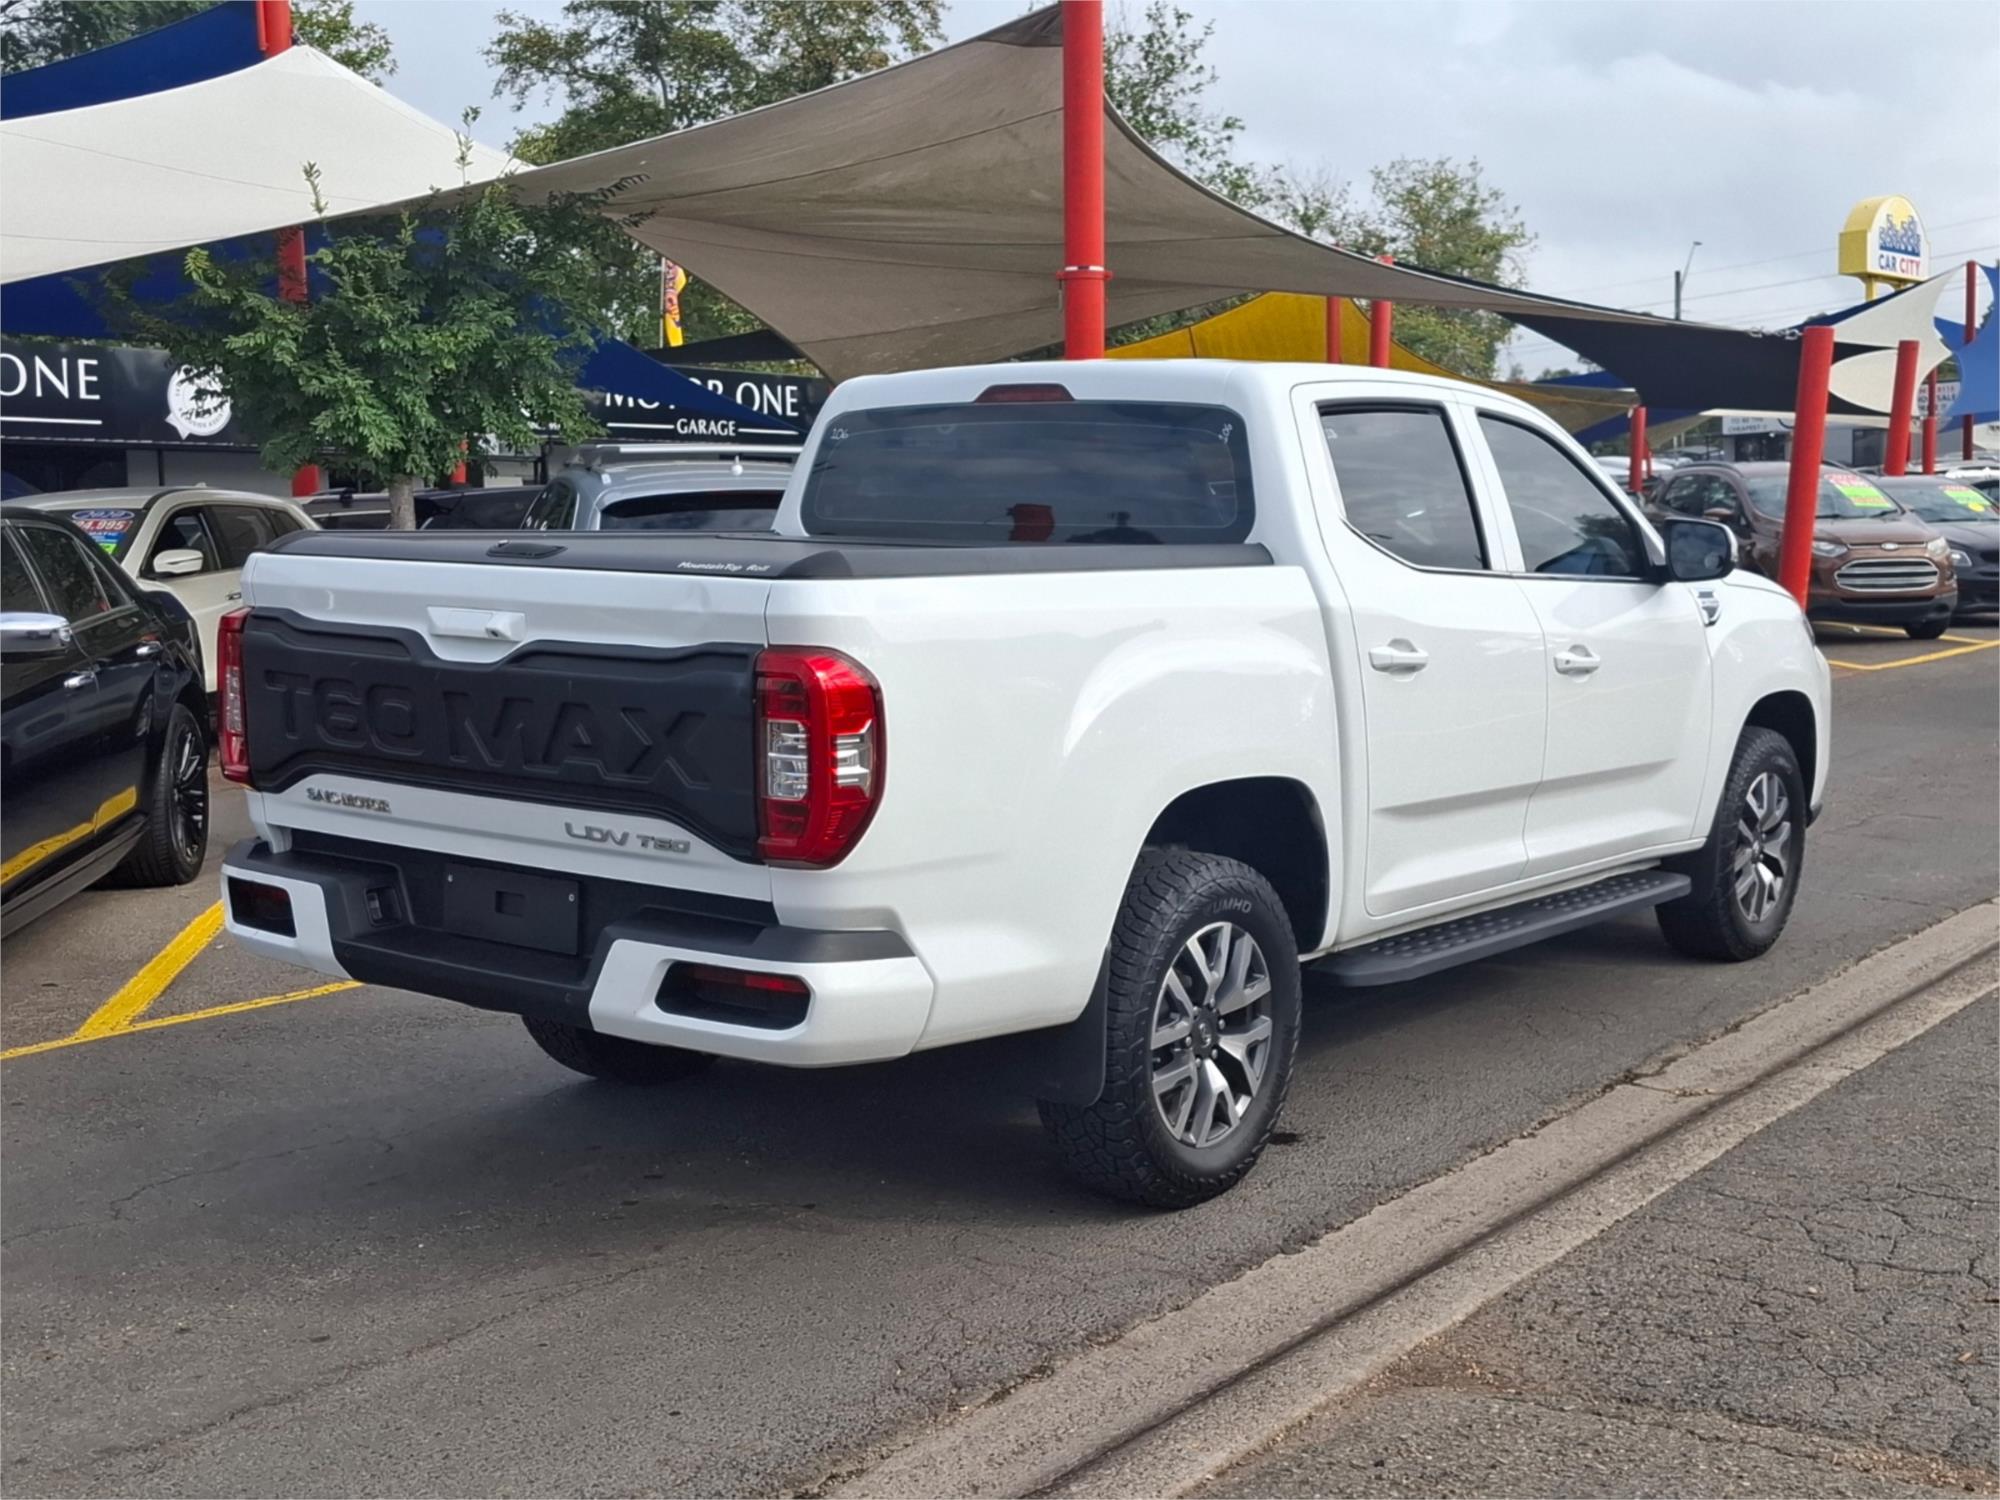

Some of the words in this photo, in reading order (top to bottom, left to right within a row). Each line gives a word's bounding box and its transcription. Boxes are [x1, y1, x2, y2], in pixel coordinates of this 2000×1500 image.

[1878, 254, 1896, 272] CAR
[1899, 257, 1921, 276] CITY
[736, 381, 799, 416] ONE
[676, 418, 736, 436] GARAGE
[263, 669, 425, 756] T60
[442, 690, 711, 790] MAX
[564, 821, 630, 847] LDV
